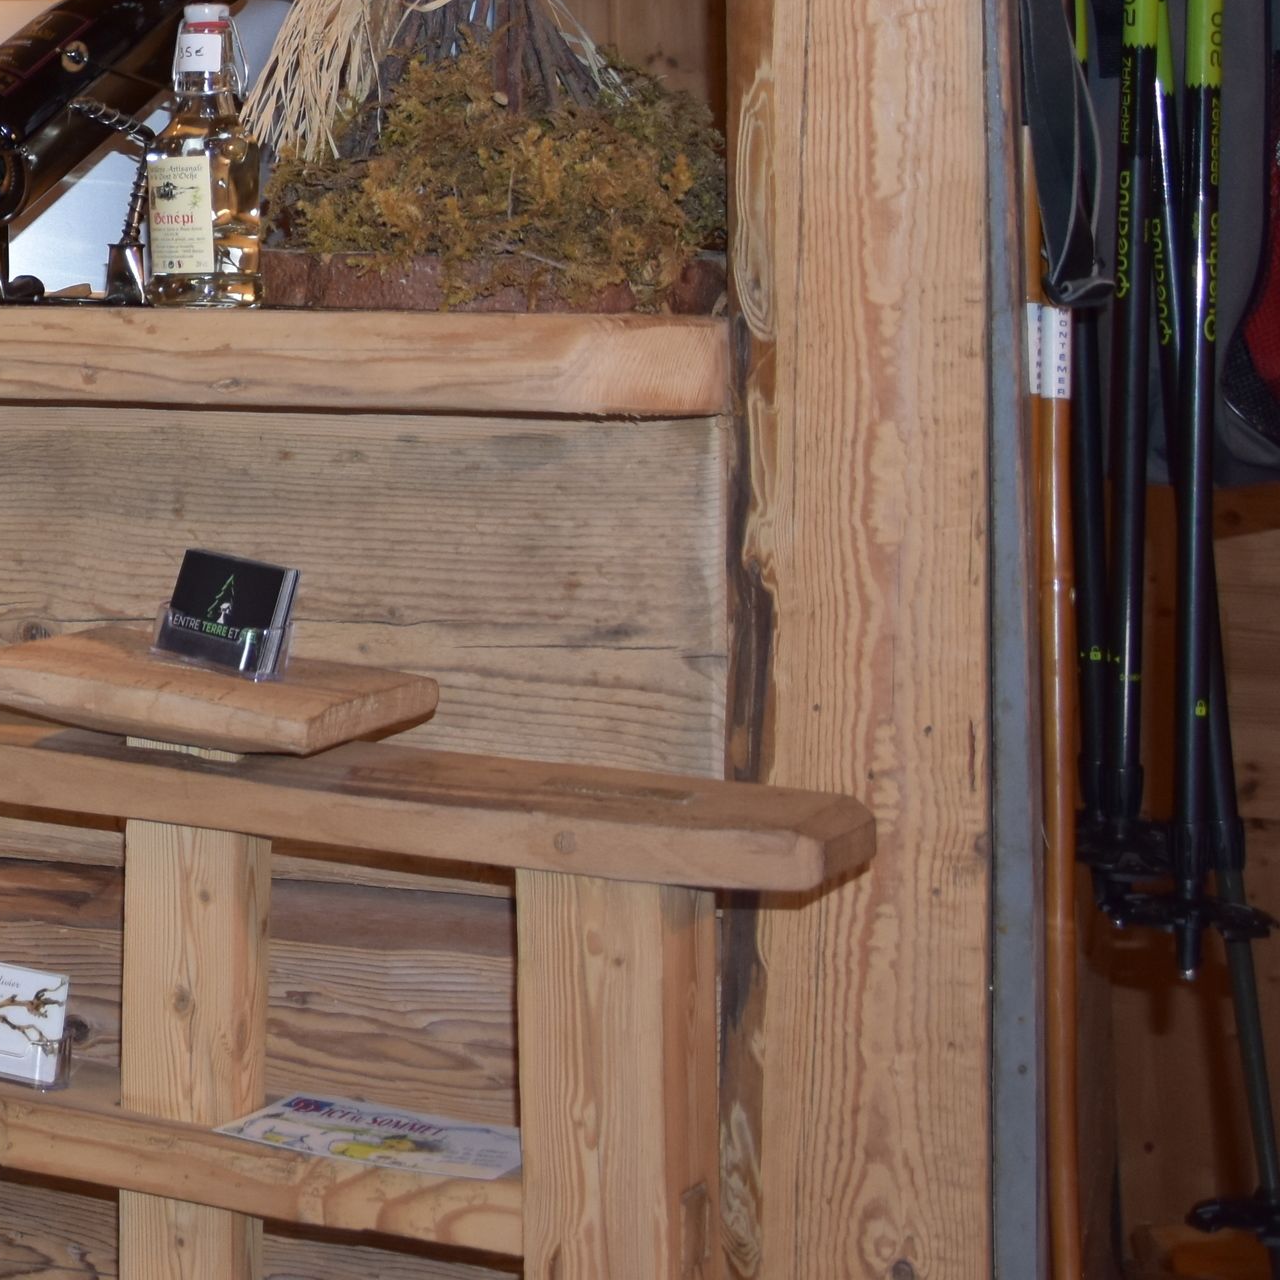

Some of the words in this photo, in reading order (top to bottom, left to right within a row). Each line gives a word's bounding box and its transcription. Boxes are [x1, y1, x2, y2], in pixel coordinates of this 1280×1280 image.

[173, 614, 201, 630] ENTRE
[202, 621, 228, 637] TERRE
[228, 627, 240, 640] ET
